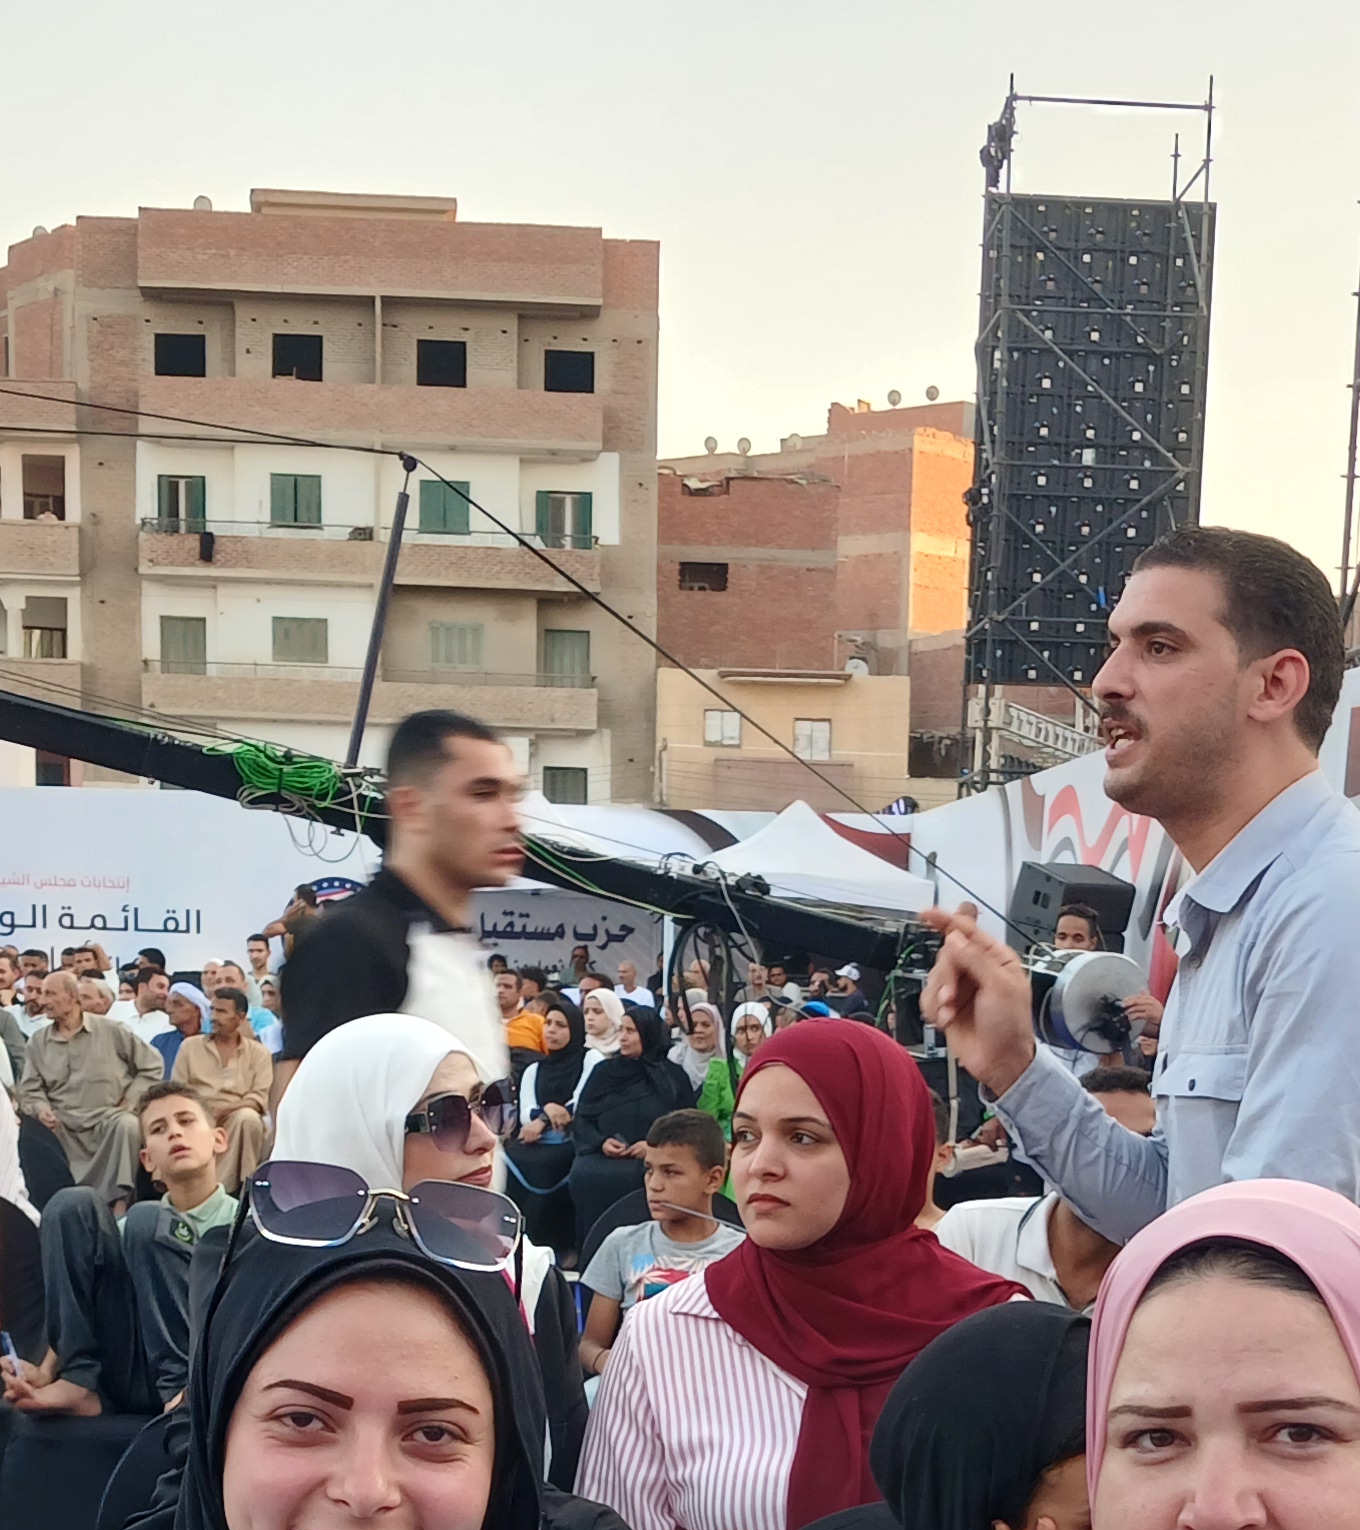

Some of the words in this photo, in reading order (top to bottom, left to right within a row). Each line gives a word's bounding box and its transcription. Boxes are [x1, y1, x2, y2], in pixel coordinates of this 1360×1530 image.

[33, 875, 77, 890] مجلس
[58, 904, 201, 934] القائمة
[573, 915, 635, 950] حزب
